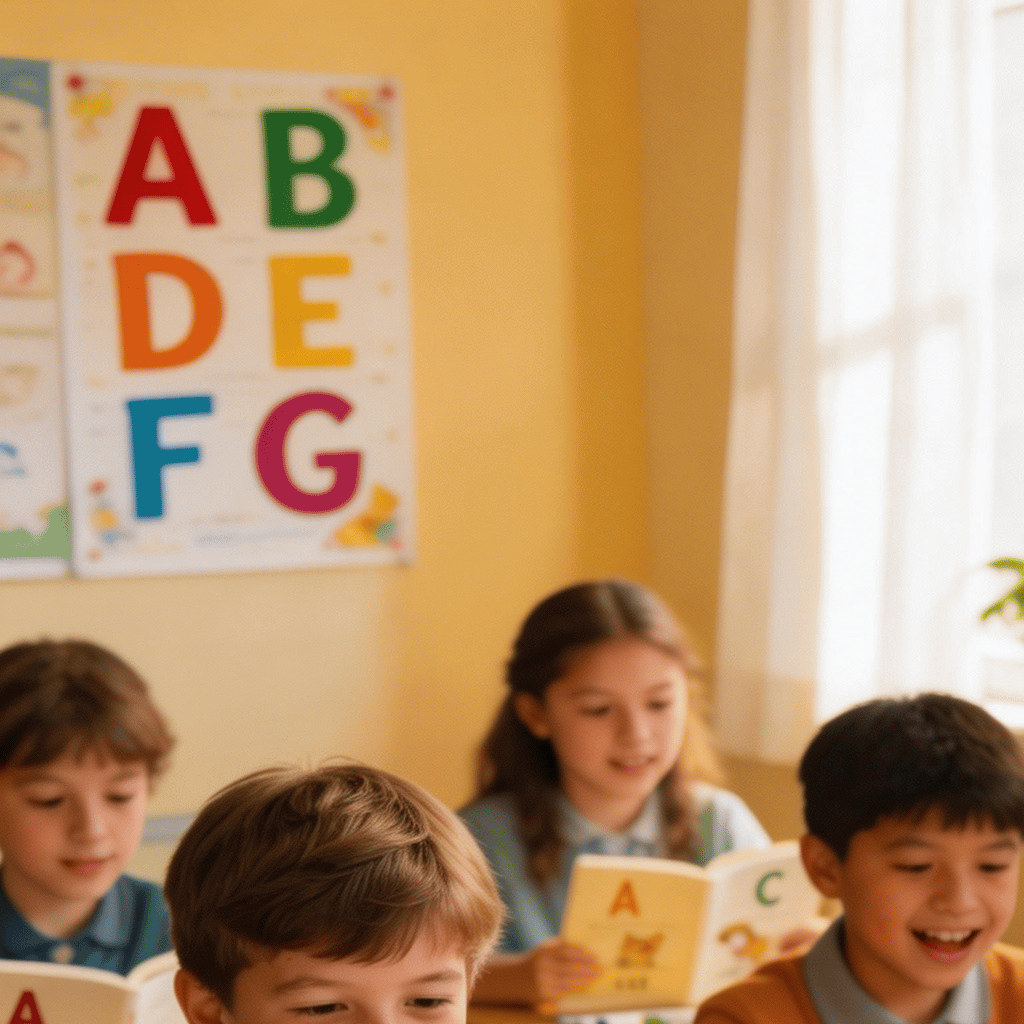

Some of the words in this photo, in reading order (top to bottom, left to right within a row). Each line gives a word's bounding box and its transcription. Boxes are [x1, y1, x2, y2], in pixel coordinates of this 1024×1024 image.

[106, 105, 220, 227] A
[261, 108, 356, 231] B
[112, 251, 226, 373] D
[268, 254, 356, 370] E
[126, 394, 215, 521] F
[254, 390, 363, 515] G
[608, 879, 641, 918] A
[755, 869, 785, 907] C
